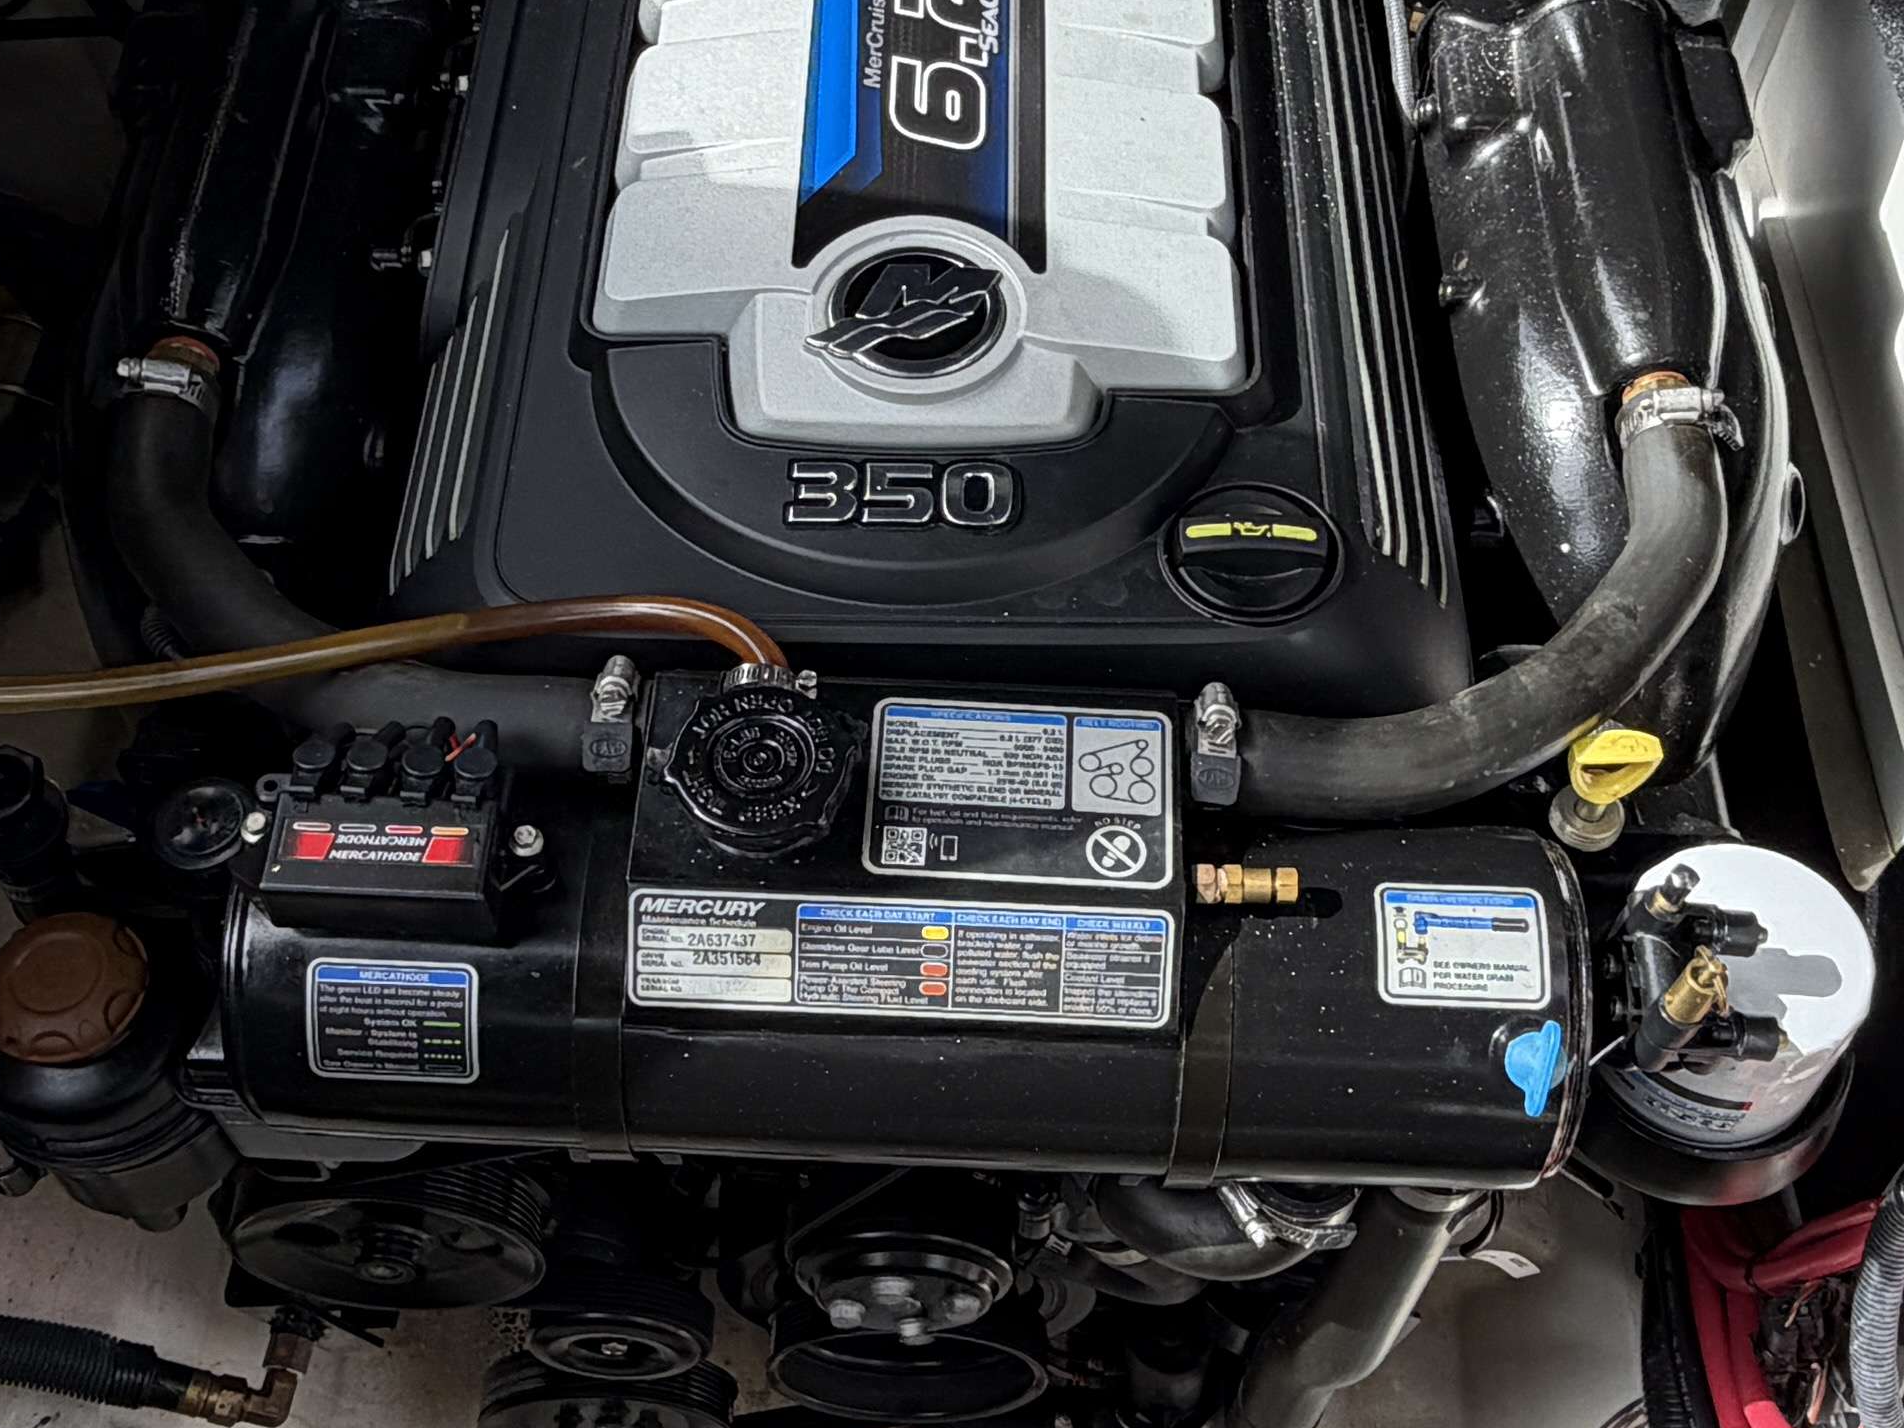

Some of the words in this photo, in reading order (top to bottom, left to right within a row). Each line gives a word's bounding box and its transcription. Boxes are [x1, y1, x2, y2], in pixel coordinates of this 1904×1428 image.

[787, 461, 1014, 525] 350
[335, 834, 426, 846] MERCATHODE
[329, 850, 422, 862] MERCATHODE
[639, 897, 765, 917] MERCURY
